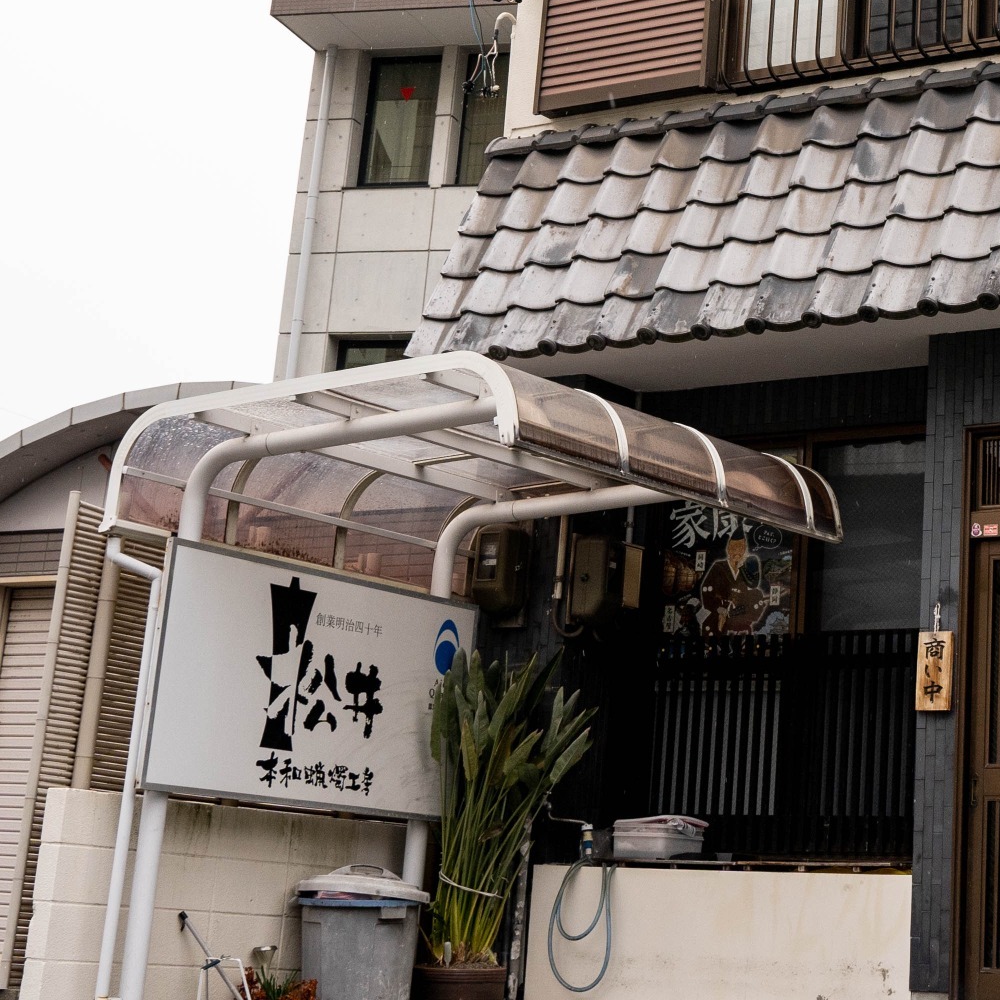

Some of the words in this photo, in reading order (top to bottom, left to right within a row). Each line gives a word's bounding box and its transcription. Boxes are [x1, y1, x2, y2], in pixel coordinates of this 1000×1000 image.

[315, 612, 384, 637] 創業明治四十年
[256, 623, 384, 739] 松井
[923, 638, 946, 704] 商い中
